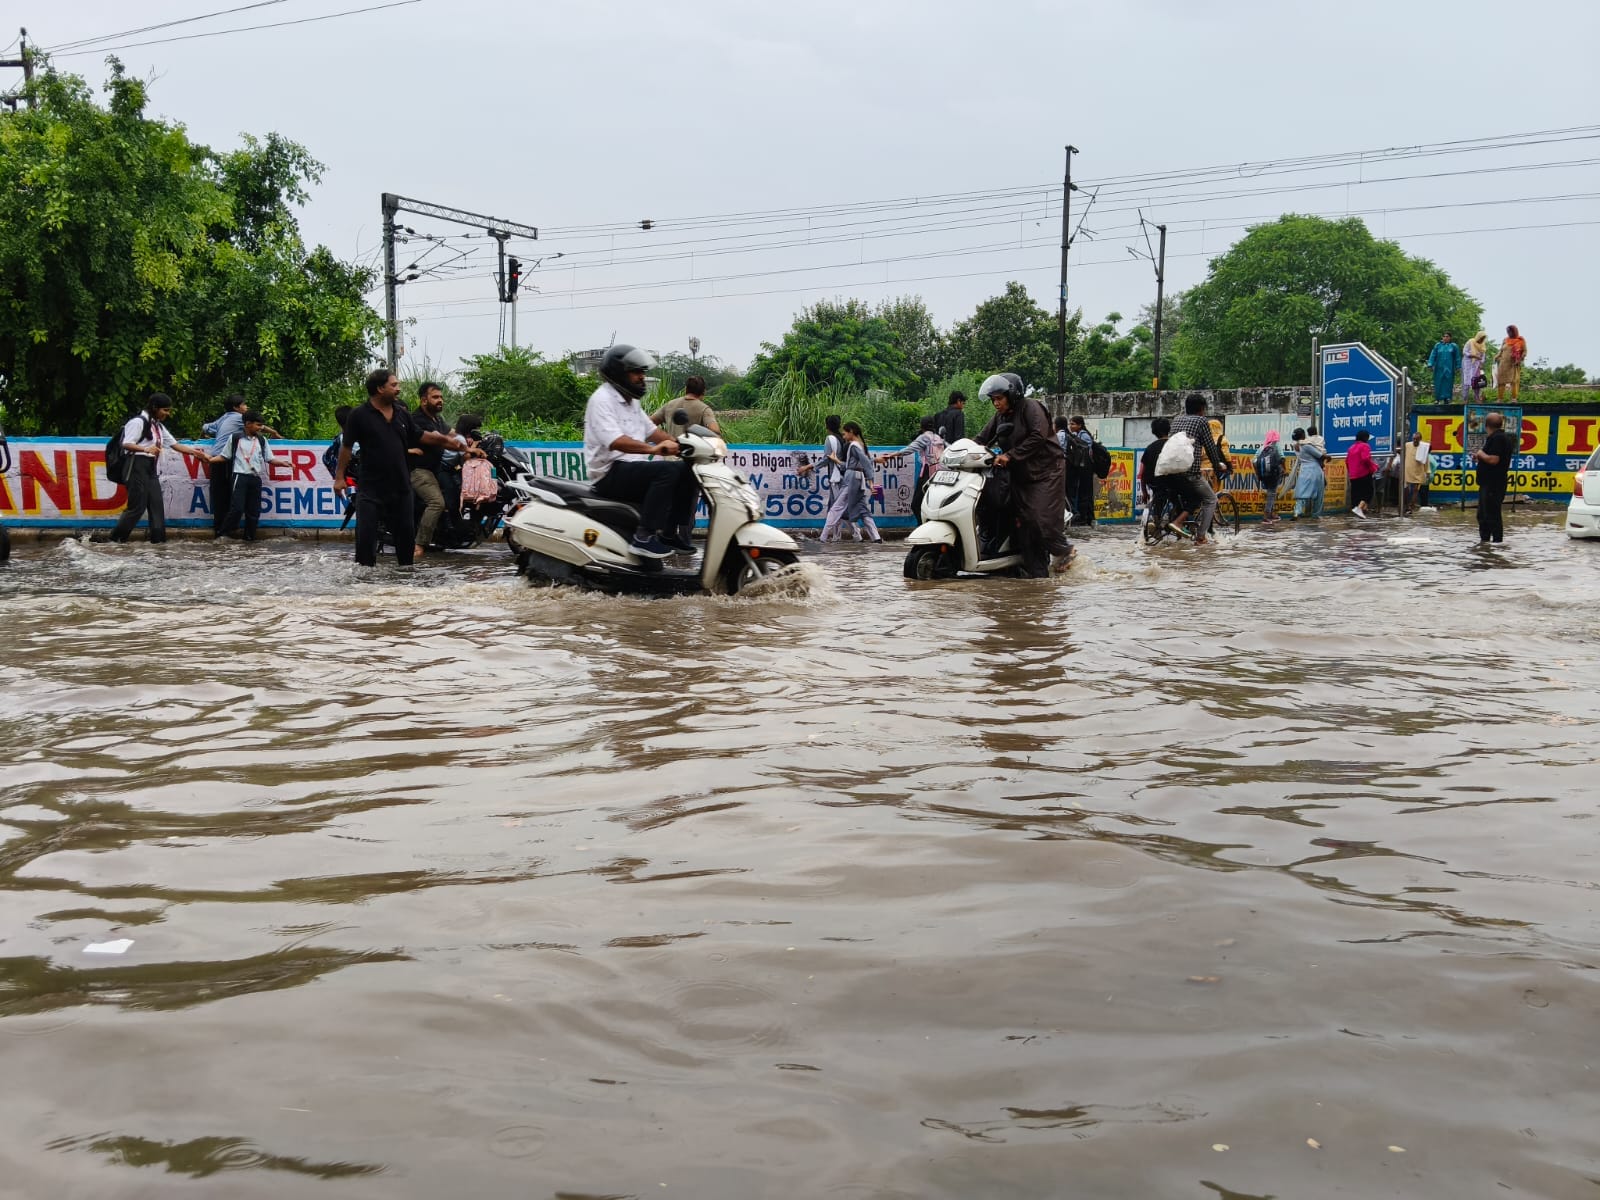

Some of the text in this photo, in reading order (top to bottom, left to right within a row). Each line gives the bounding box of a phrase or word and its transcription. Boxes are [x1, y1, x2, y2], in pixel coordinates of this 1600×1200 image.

[1326, 392, 1345, 410] शहीद
[1368, 389, 1390, 406] चैतन्य
[1332, 410, 1383, 428] केशव शर्मा मार्ग
[1426, 418, 1538, 451] IS
[1567, 418, 1600, 452] I
[182, 449, 317, 482] WER
[732, 452, 747, 466] to
[752, 453, 791, 472] Bhigan
[1531, 474, 1562, 491] Snp.
